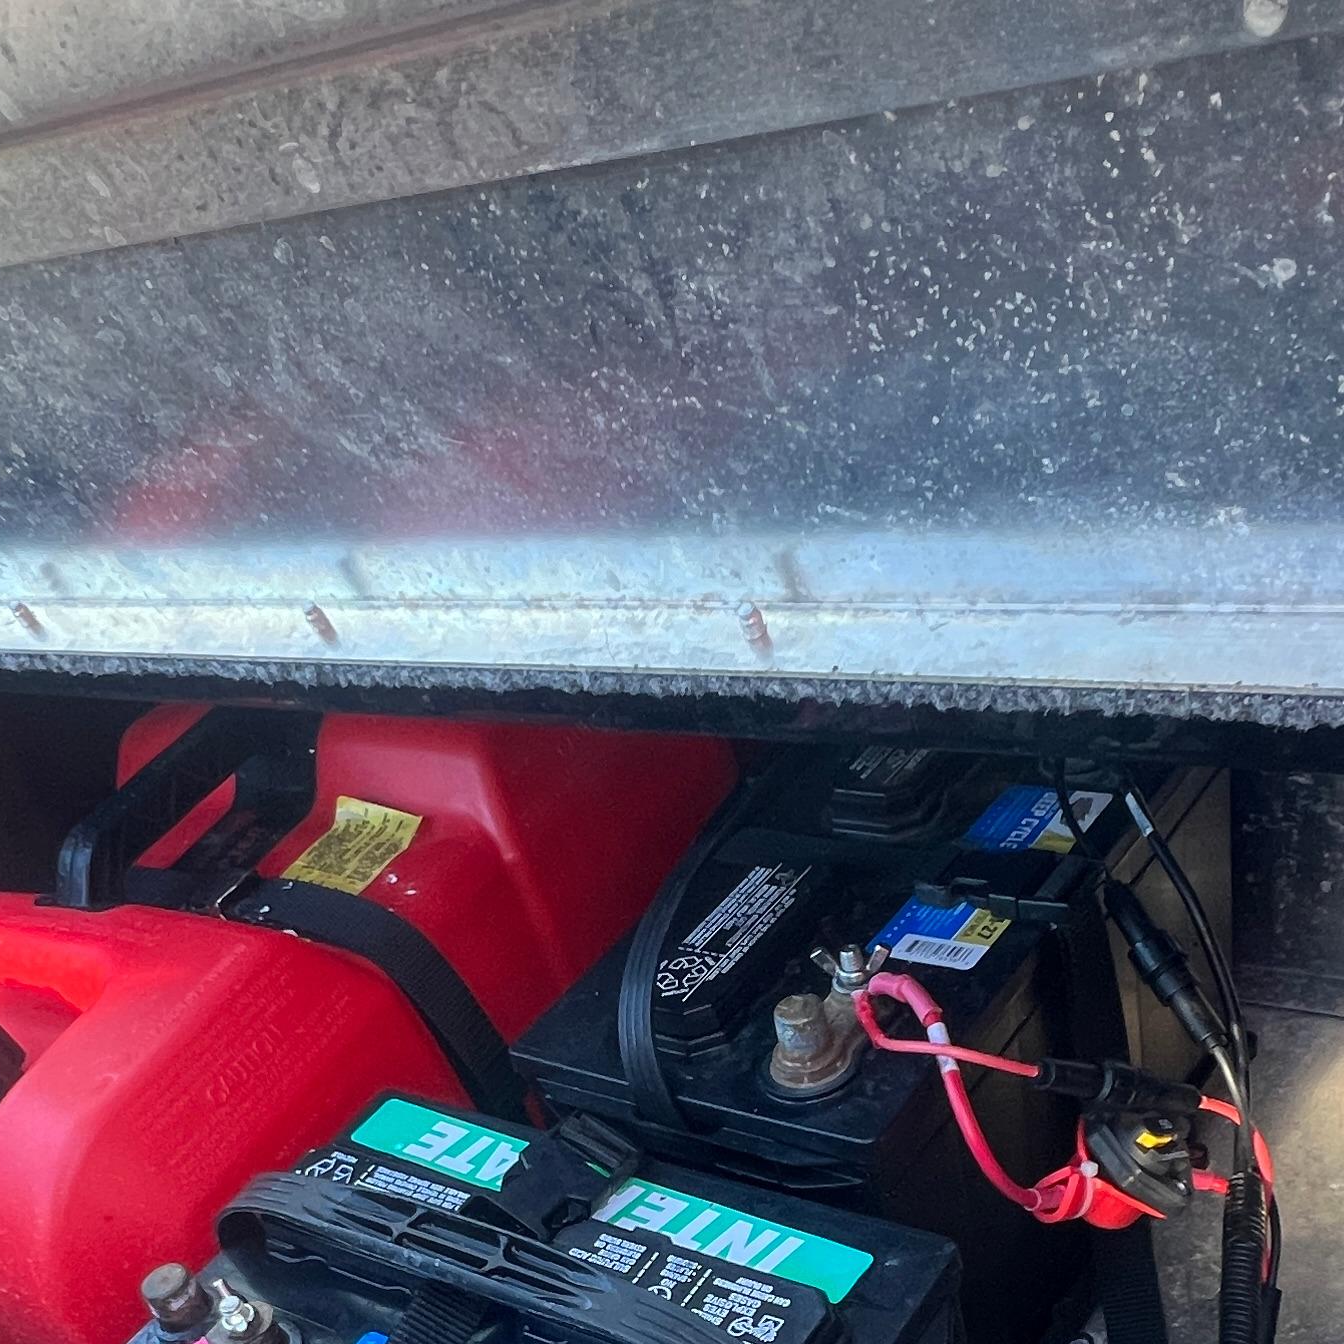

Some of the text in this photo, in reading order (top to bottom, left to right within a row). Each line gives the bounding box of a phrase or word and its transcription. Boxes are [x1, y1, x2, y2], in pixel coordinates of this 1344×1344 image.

[567, 1246, 594, 1261] ACID
[658, 1277, 677, 1289] NO
[702, 1291, 756, 1317] EXPLOSIVE
[727, 1291, 762, 1308] GASES
[701, 1302, 729, 1317] EYES
